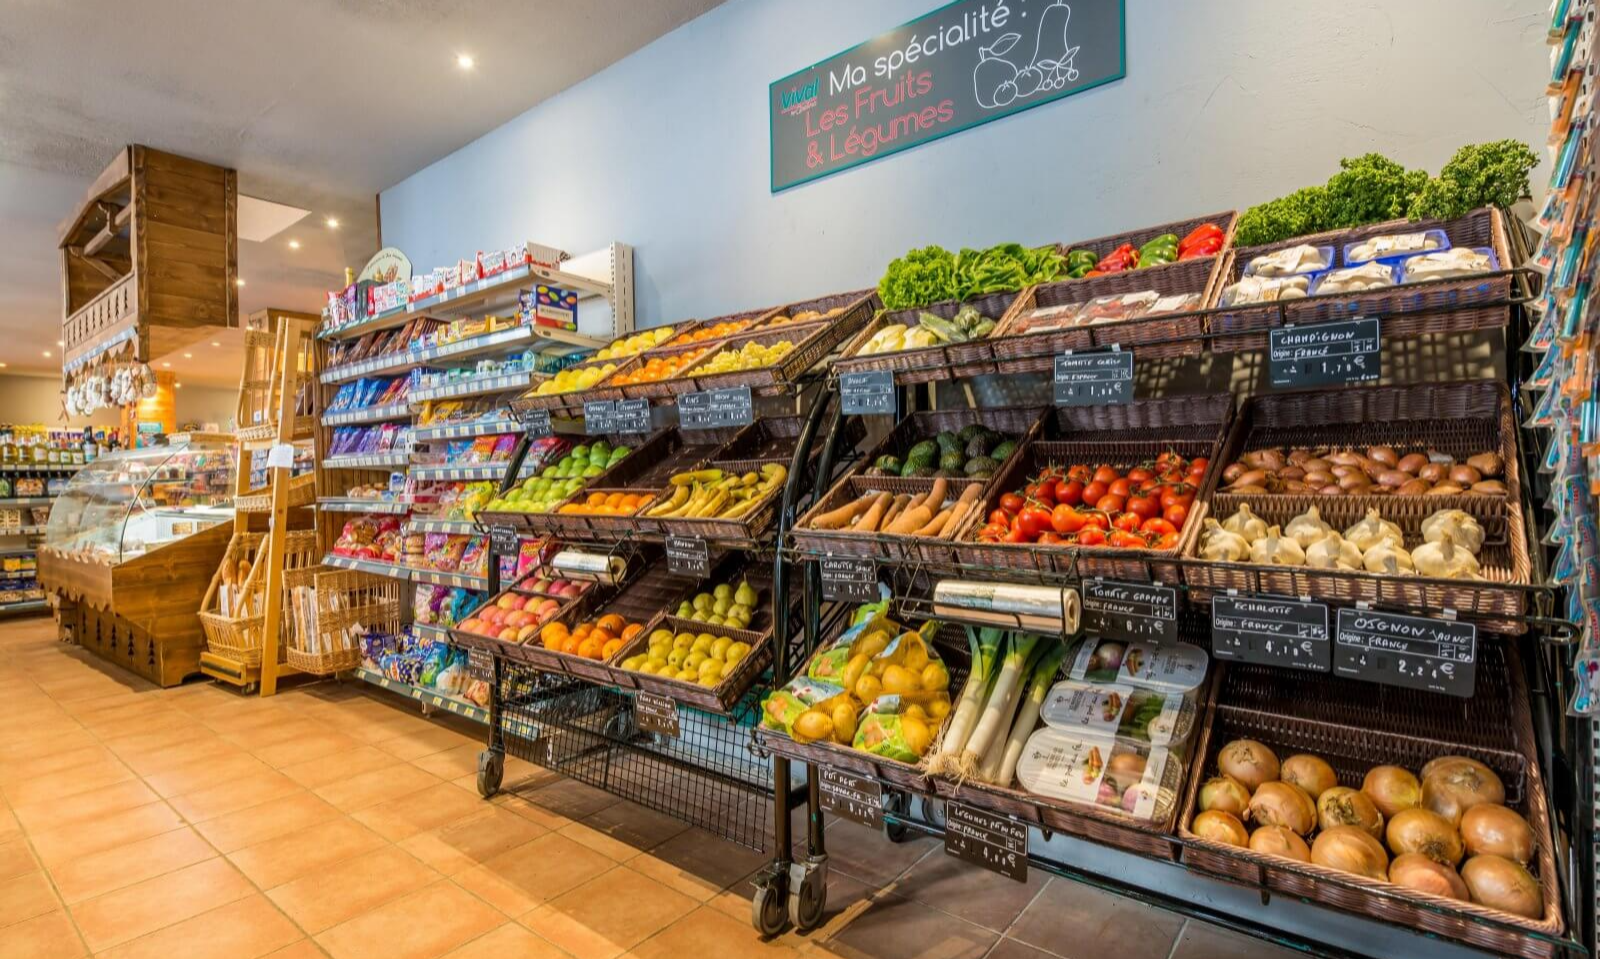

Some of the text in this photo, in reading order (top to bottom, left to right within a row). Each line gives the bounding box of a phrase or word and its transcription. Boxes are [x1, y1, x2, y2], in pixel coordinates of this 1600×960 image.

[829, 63, 866, 96] Ma
[874, 0, 1010, 80] spécialité
[805, 102, 848, 138] Les
[854, 67, 933, 119] Fruits
[806, 99, 954, 168] & Légumes
[1354, 618, 1426, 637] OIGNON
